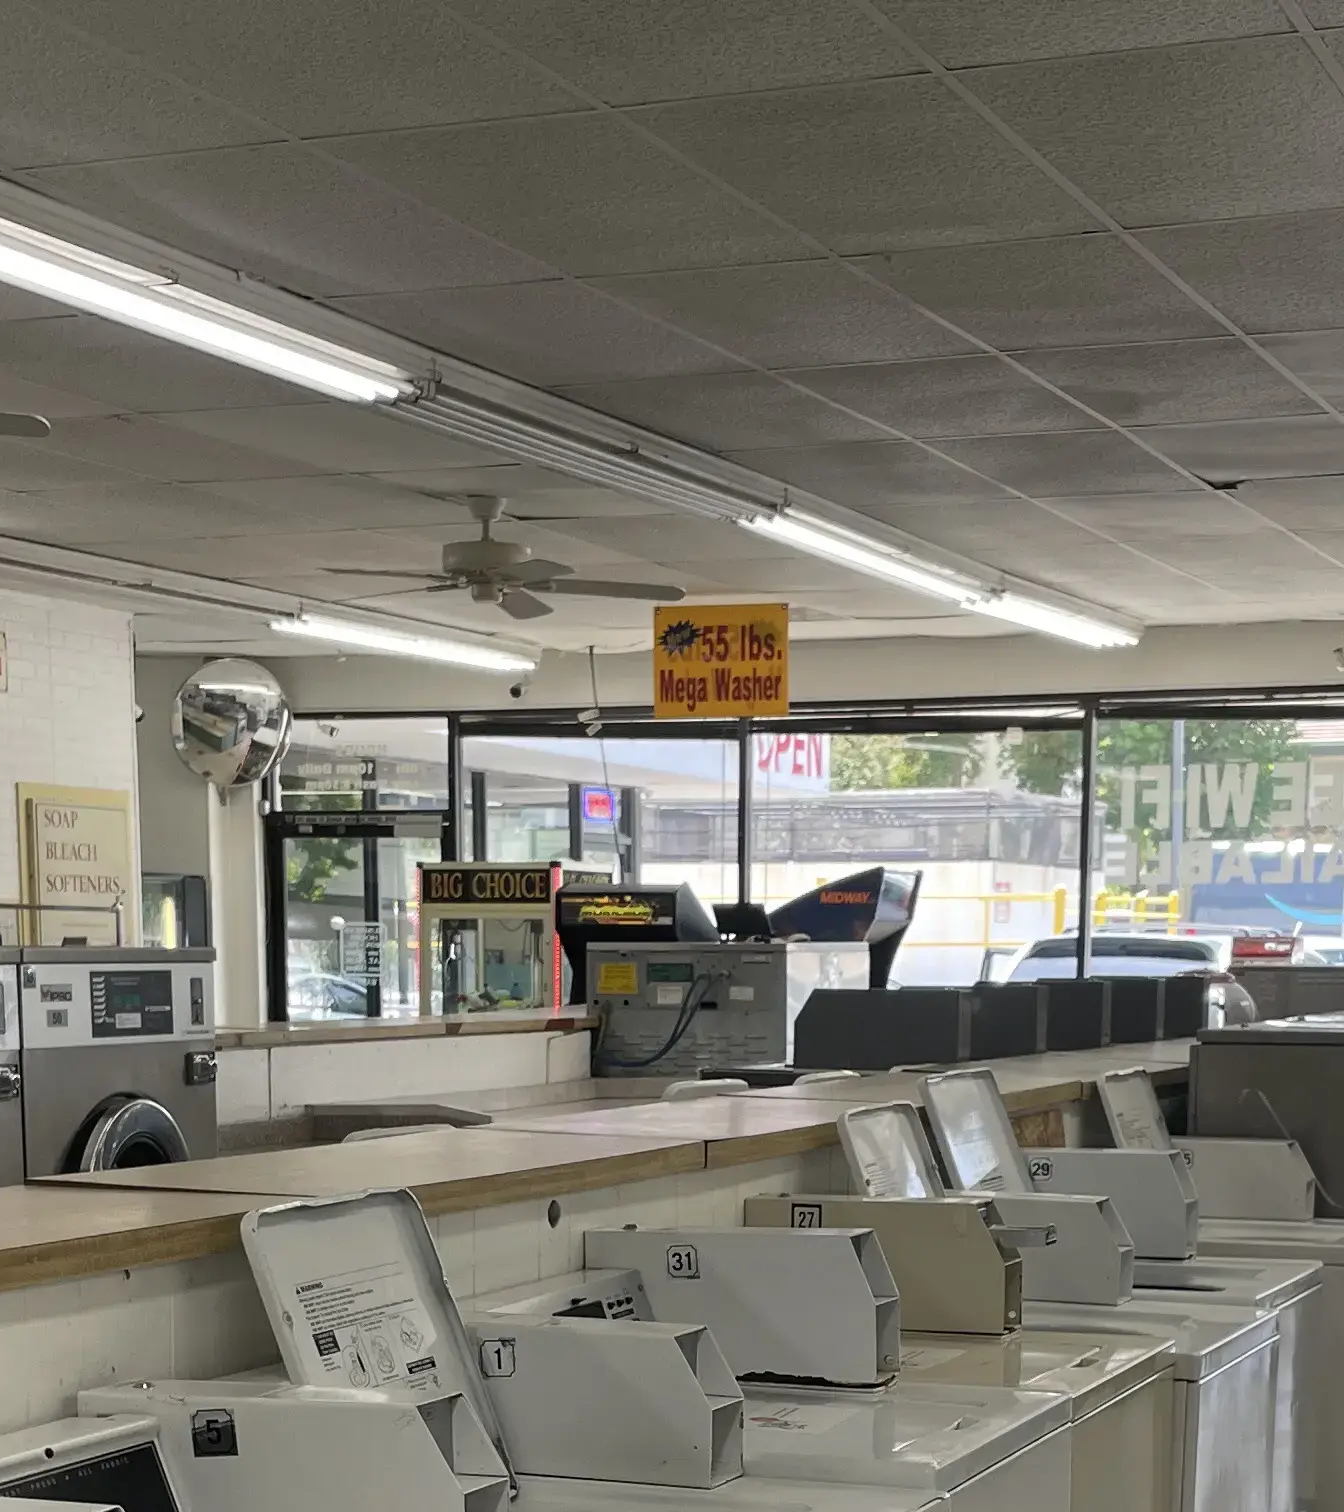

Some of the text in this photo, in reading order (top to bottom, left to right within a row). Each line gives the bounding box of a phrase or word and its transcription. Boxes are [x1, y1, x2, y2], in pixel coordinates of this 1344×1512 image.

[702, 624, 782, 662] 55 lbs.
[660, 668, 782, 712] Mega Washer
[758, 733, 823, 778] OPEN
[44, 808, 79, 830] SOAP
[46, 843, 98, 862] BLEACH
[46, 874, 122, 894] SOFTENERS
[430, 872, 463, 898] BIG
[472, 872, 547, 898] CHOICE
[820, 891, 871, 904] MIDWAY
[1032, 1162, 1050, 1176] 29
[798, 1212, 815, 1228] 27
[672, 1251, 692, 1271] 31
[206, 1419, 222, 1445] 5
